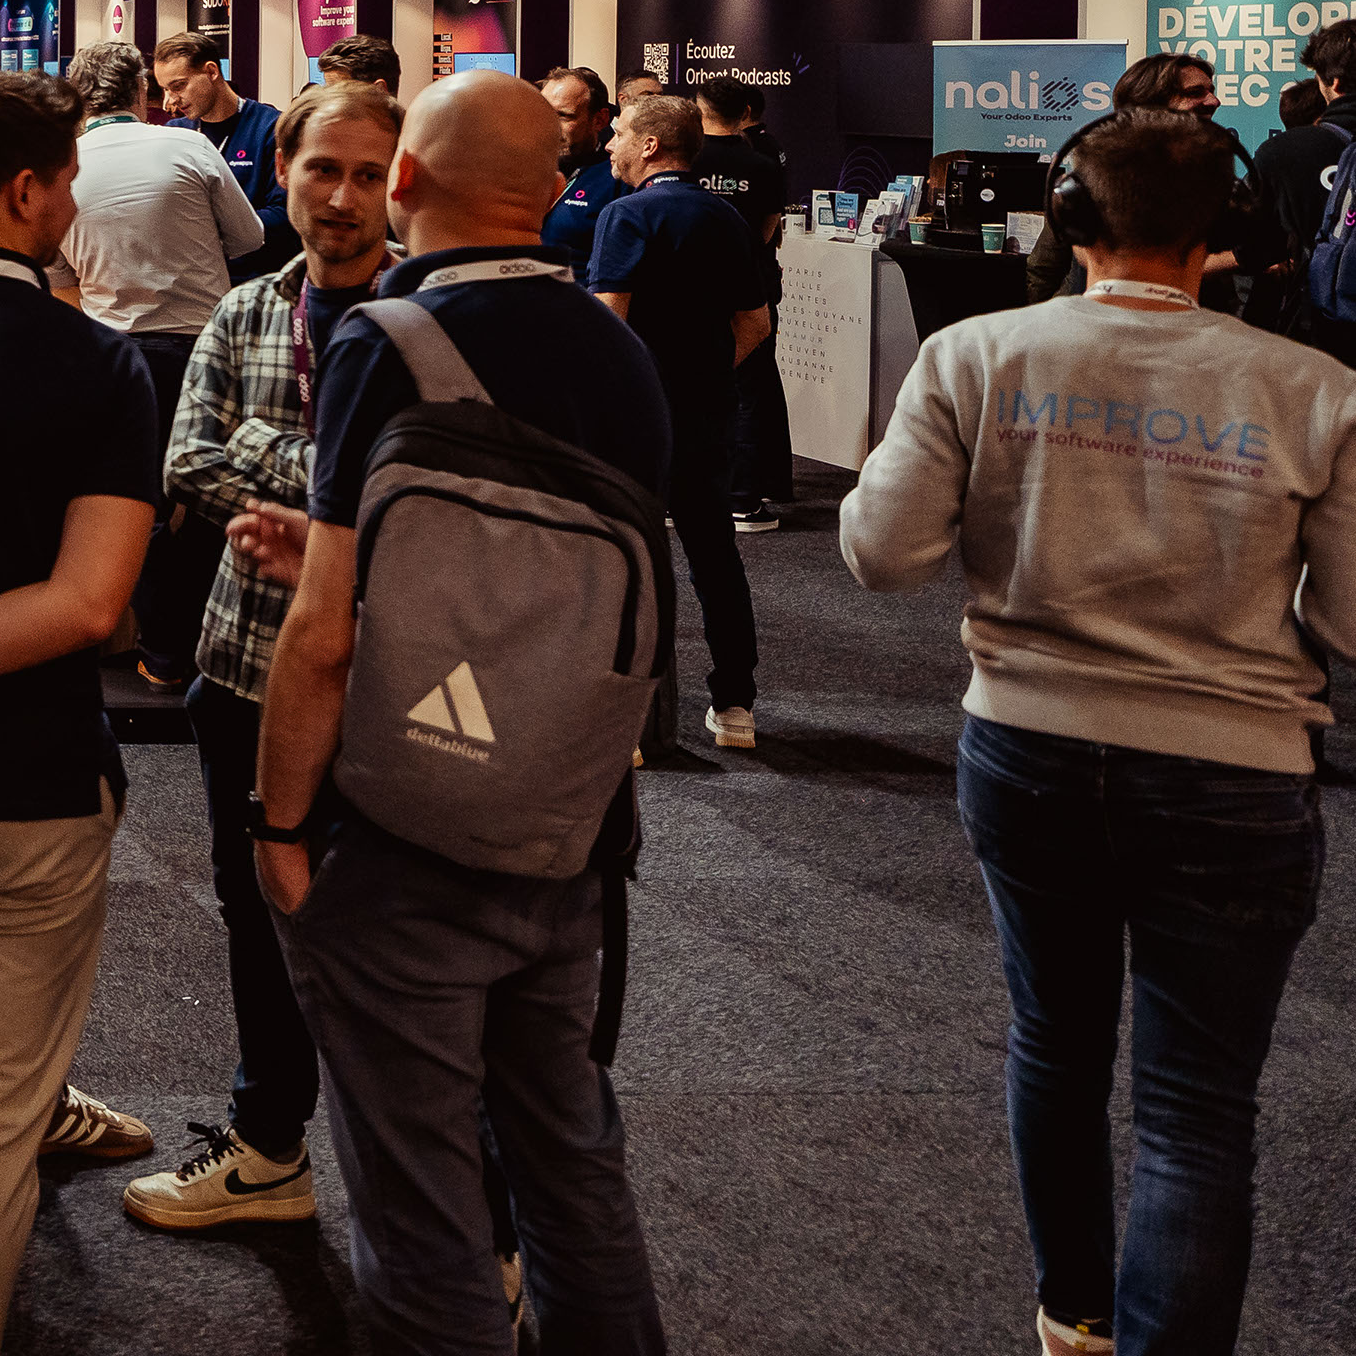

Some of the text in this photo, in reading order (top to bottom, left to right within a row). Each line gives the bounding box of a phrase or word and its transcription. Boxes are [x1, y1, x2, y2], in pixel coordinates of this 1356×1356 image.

[321, 5, 343, 16] Improve
[312, 16, 336, 27] software
[687, 38, 735, 59] Écoutez
[945, 70, 1111, 112] nalios
[981, 113, 1073, 122] Your Odoo Experts
[1004, 133, 1047, 148] Join
[564, 198, 589, 207] dynapps
[499, 262, 535, 275] odoo
[788, 266, 822, 278] PARIS
[789, 281, 821, 291] LILLE
[783, 293, 827, 305] NANTES
[779, 317, 838, 333] RUXELLES
[785, 331, 823, 344] NAMUR
[781, 343, 825, 358] LEUVEN
[781, 356, 834, 373] AUSANNE
[298, 373, 311, 403] odoo
[997, 389, 1272, 462] IMPROVE
[996, 428, 1265, 479] your software experience
